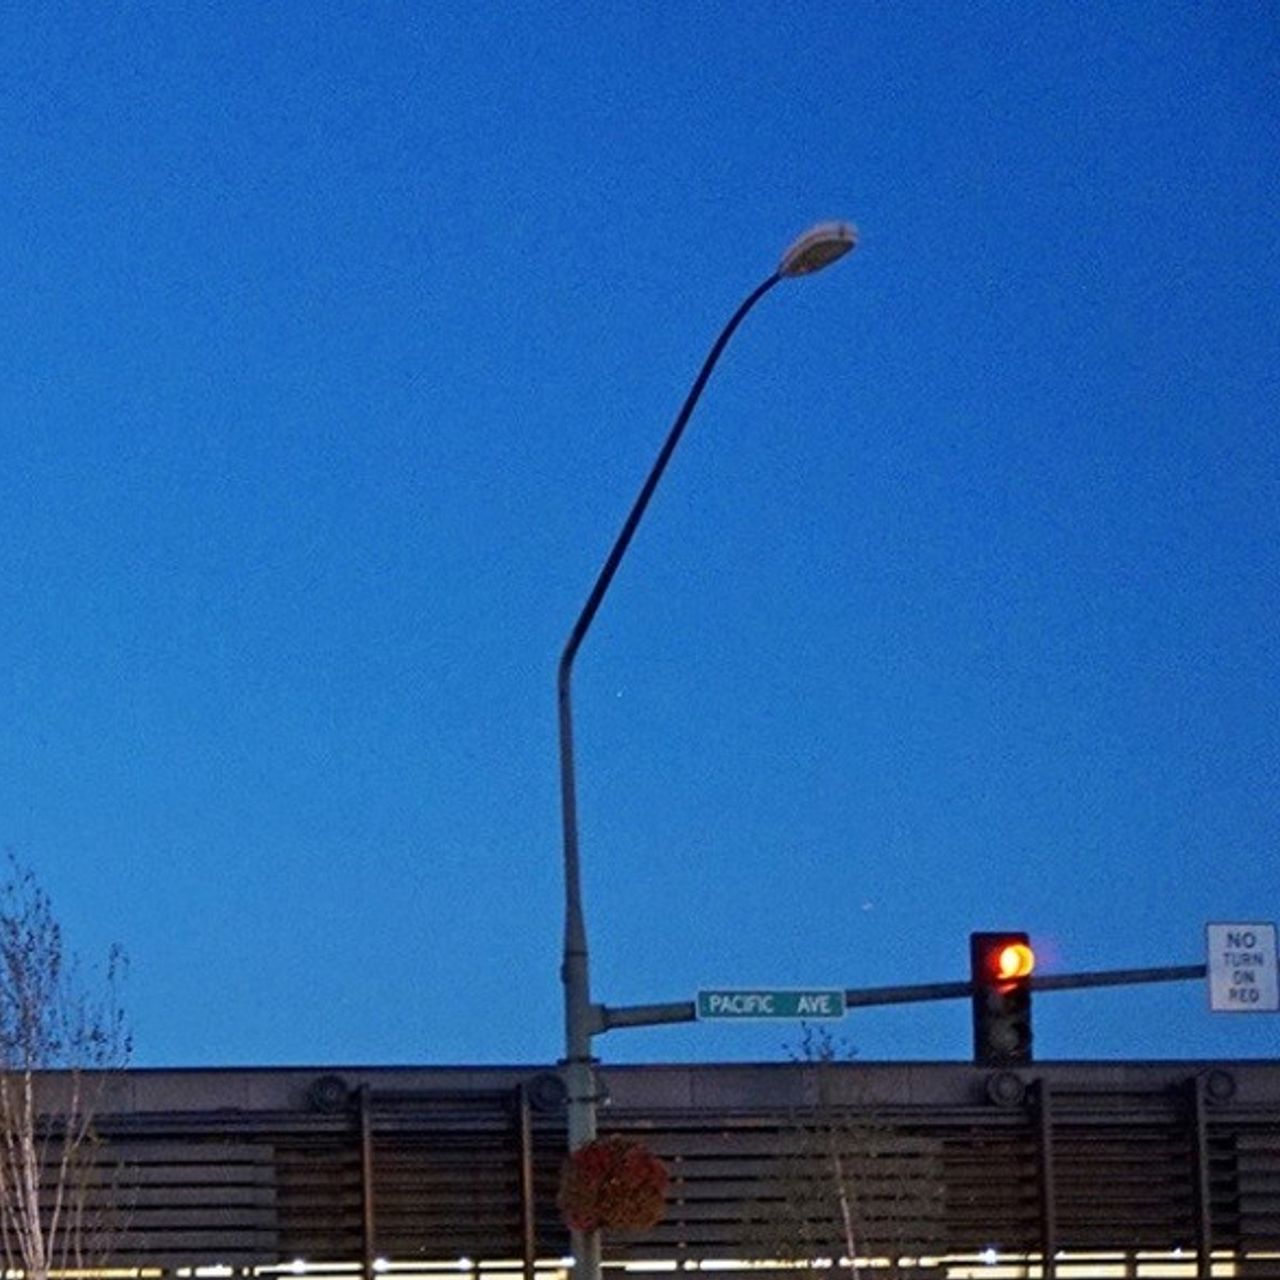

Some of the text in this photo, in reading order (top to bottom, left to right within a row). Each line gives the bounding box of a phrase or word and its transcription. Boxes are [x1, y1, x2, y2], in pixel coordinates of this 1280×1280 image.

[1226, 931, 1257, 949] NO
[1223, 951, 1265, 967] TURN
[1233, 969, 1256, 985] ON
[1228, 987, 1260, 1003] RED
[708, 993, 832, 1014] PACIFIC AVE
